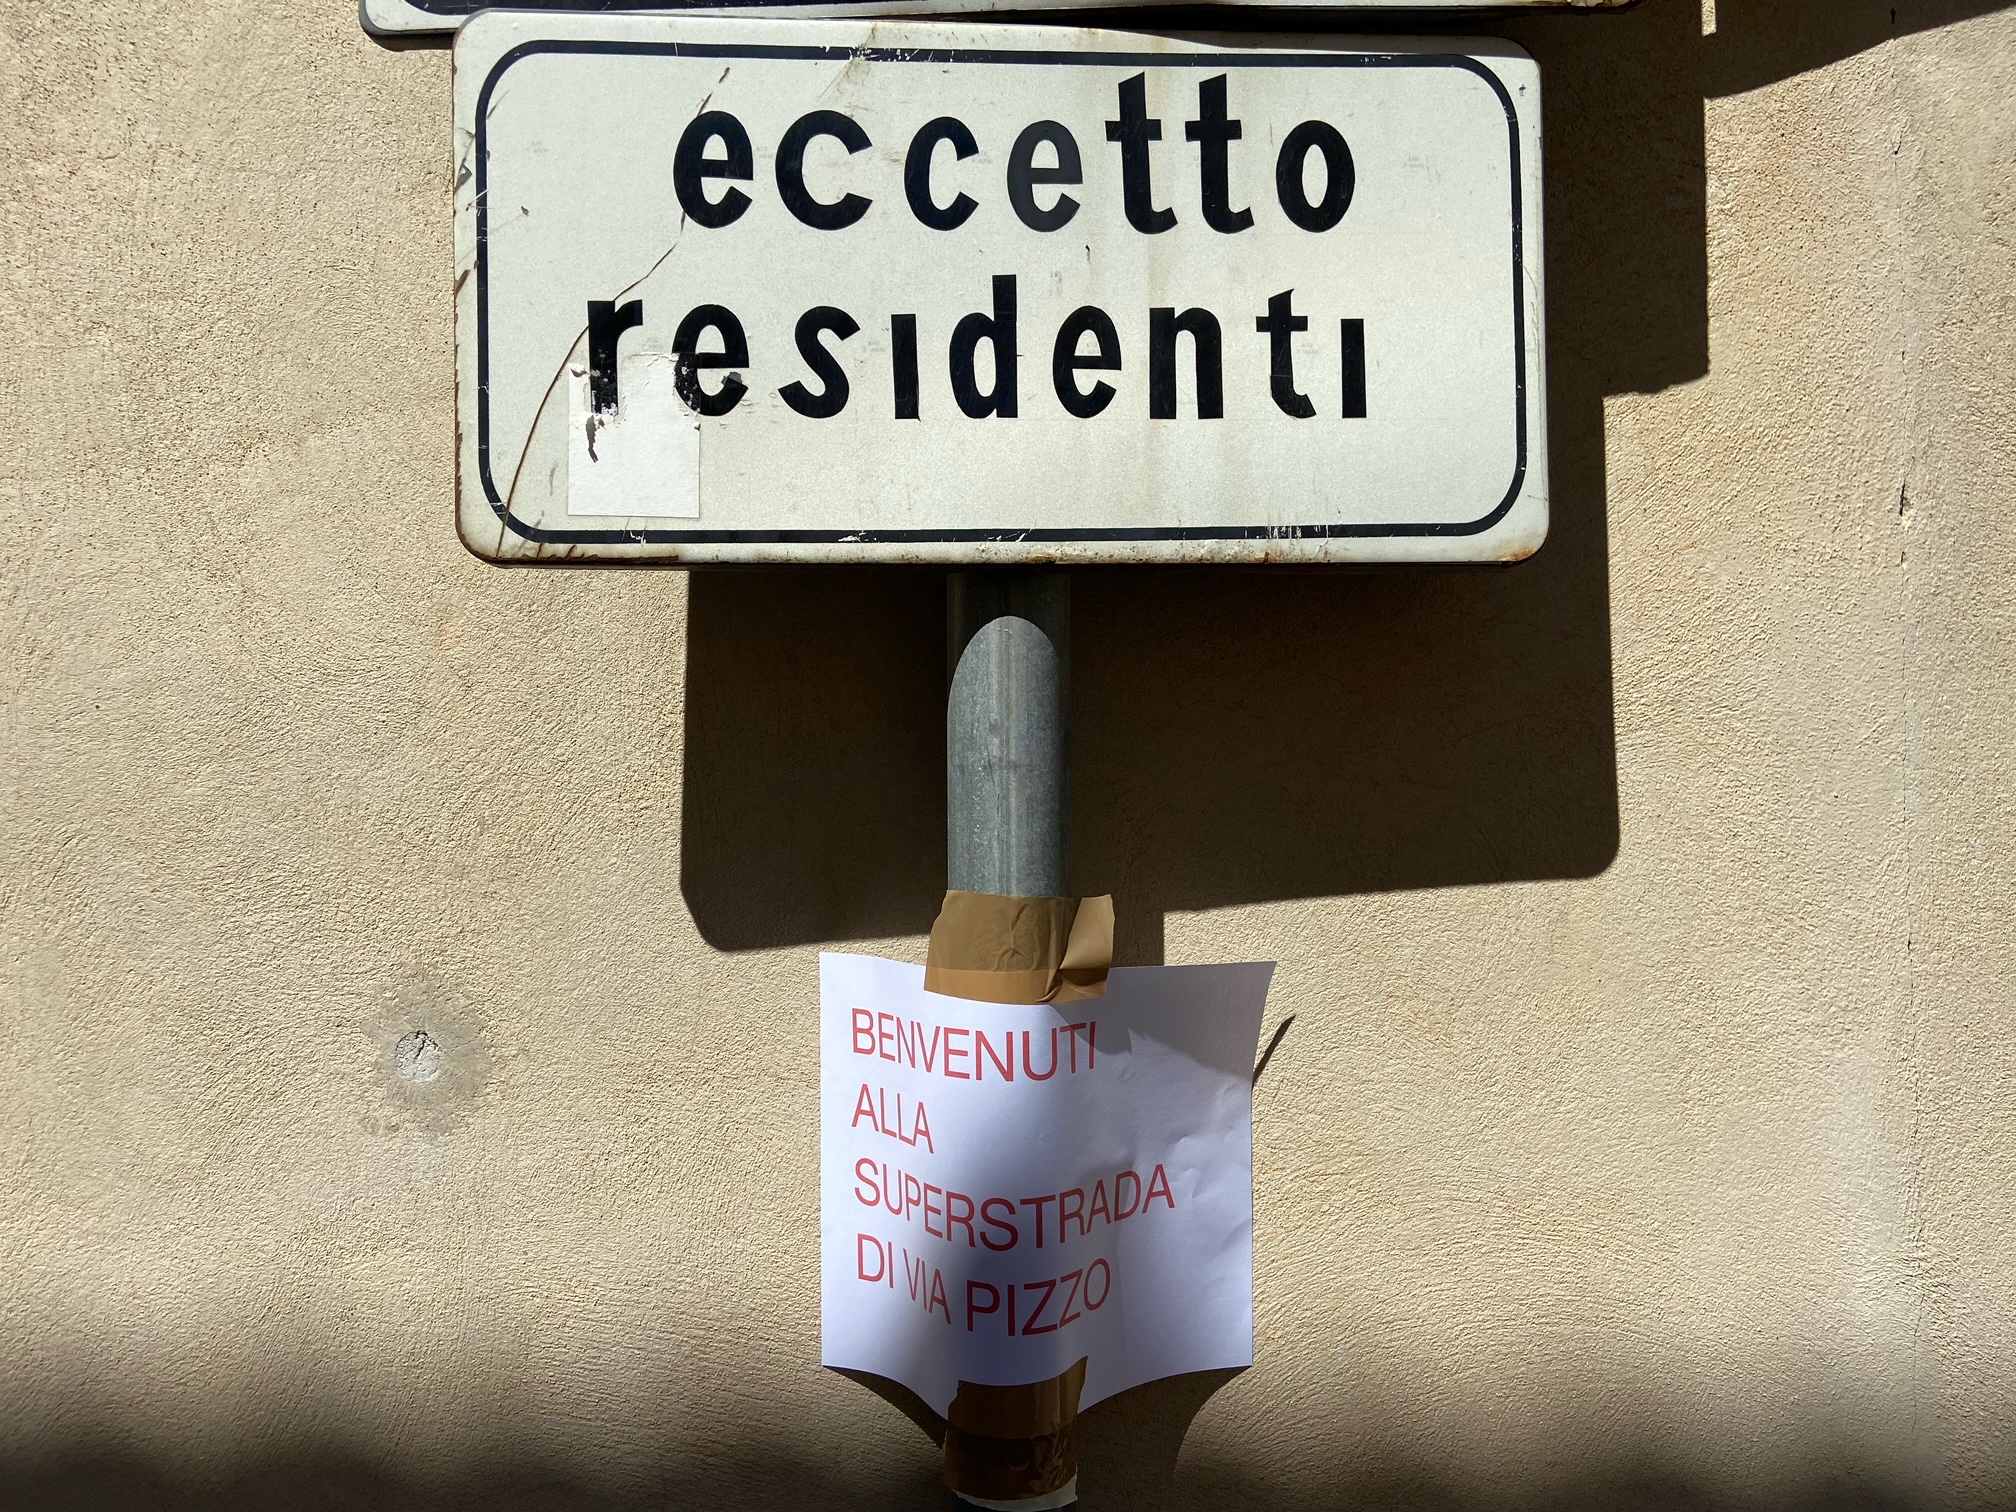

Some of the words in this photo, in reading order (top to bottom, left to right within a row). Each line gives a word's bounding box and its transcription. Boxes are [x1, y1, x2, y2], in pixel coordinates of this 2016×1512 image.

[673, 71, 1356, 235] eccetto
[851, 1007, 1097, 1082] BENVENUTI
[851, 1083, 935, 1154] ALLA
[854, 1157, 1176, 1252] SUPERSTRADA
[856, 1233, 895, 1289] DI
[902, 1248, 952, 1325] VIA
[966, 1258, 1112, 1337] PIZZO
